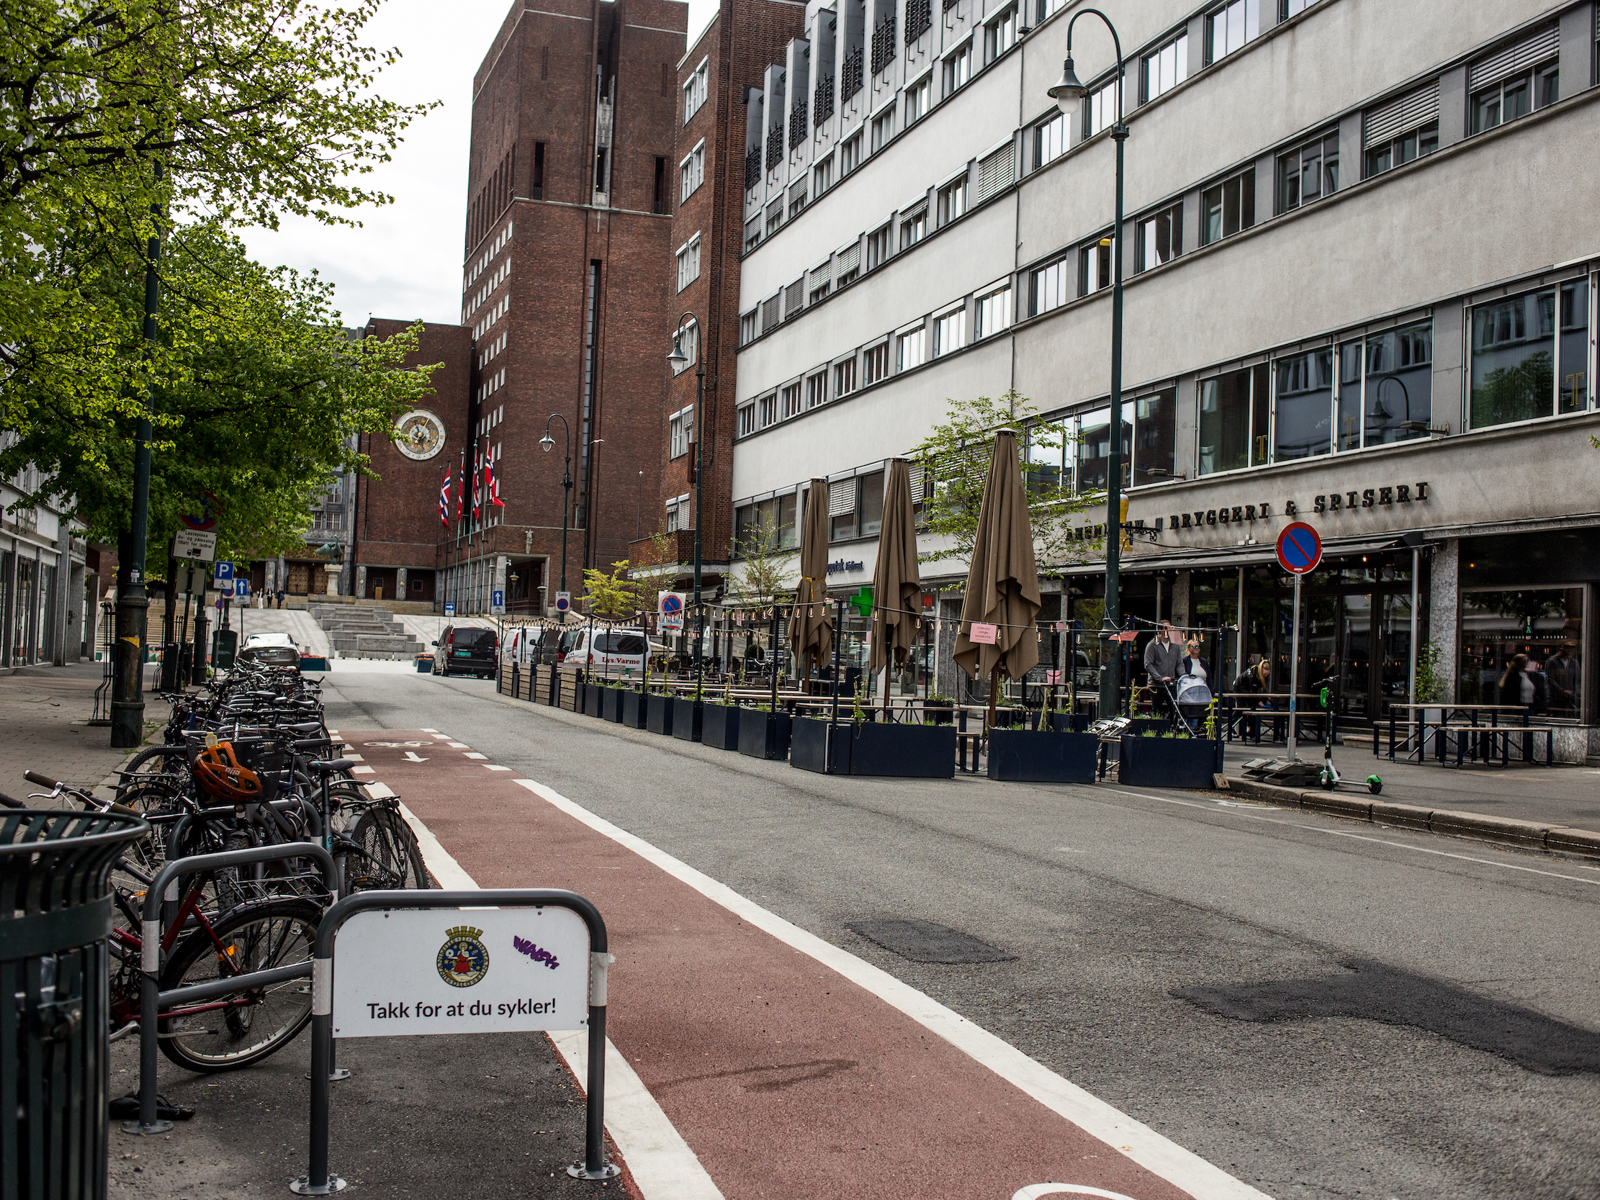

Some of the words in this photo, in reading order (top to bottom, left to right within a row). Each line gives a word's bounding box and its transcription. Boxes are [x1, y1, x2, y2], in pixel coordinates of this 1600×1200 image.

[1169, 503, 1270, 530] BRYGGERI
[1285, 500, 1297, 516] &
[1313, 482, 1428, 513] SPISERI
[219, 564, 229, 577] P
[601, 656, 615, 665] Lys
[616, 657, 641, 665] Varme
[366, 1001, 410, 1019] Takk
[415, 1001, 442, 1018] for
[446, 1001, 465, 1017] at
[469, 999, 492, 1016] du
[497, 998, 556, 1019] sykler!
